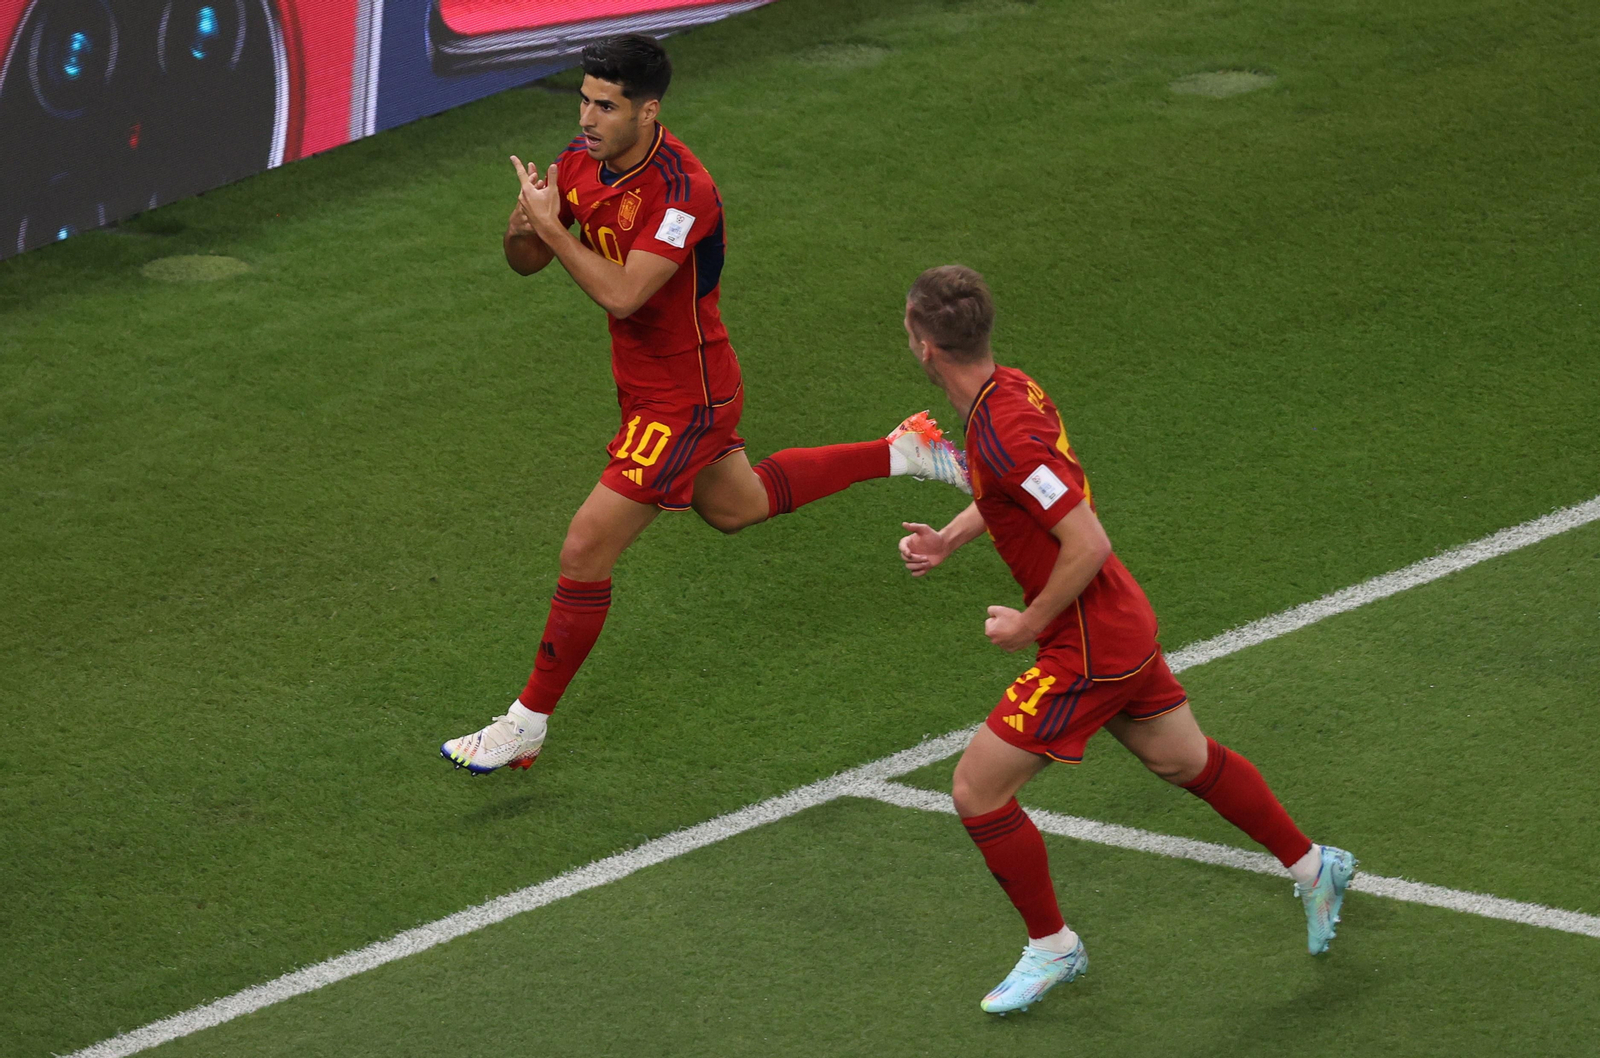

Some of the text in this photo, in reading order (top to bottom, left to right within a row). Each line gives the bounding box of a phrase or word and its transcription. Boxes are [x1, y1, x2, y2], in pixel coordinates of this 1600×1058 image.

[584, 222, 624, 267] 10
[615, 415, 672, 467] 10
[1006, 666, 1056, 716] 21
